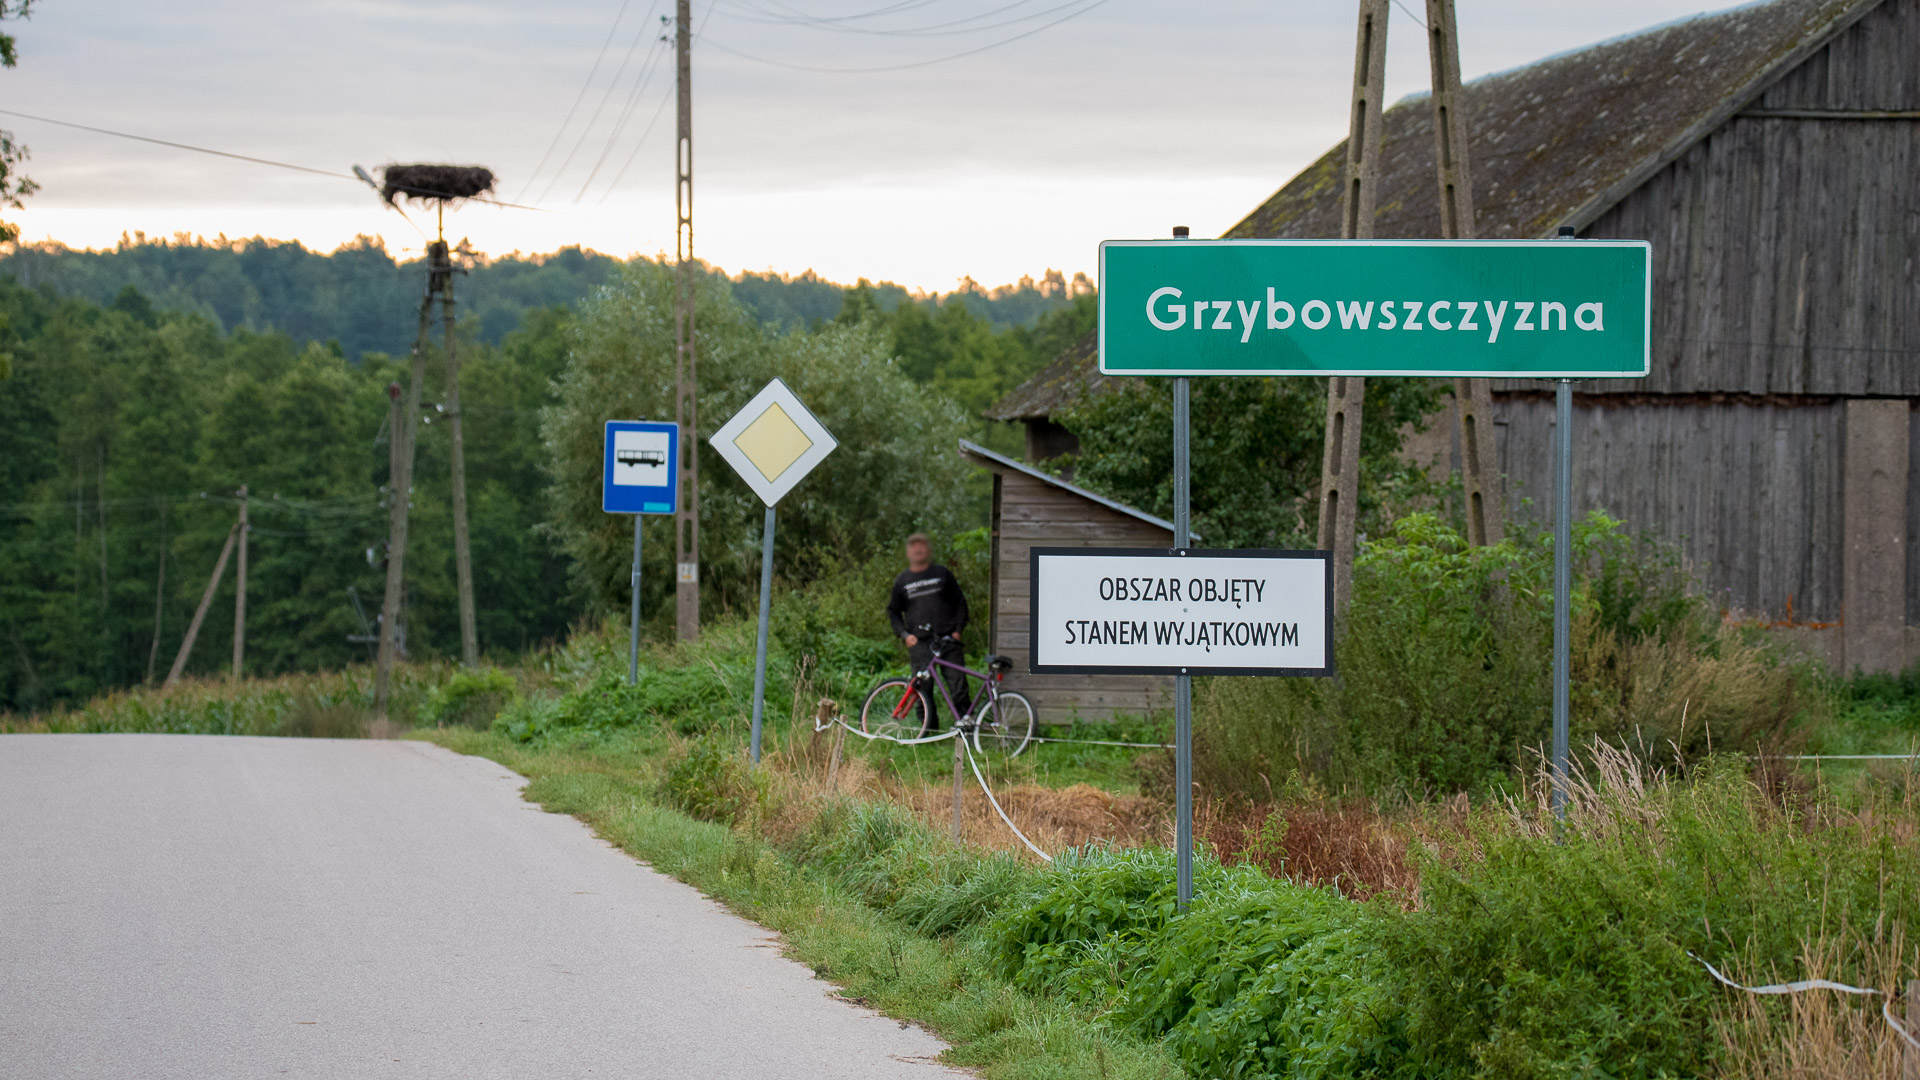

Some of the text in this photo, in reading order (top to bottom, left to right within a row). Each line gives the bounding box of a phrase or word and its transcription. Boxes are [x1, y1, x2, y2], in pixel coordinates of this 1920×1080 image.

[1145, 286, 1605, 344] Grzybowszczyzna
[1099, 577, 1266, 610] OBSZAR OBJĘTY
[1065, 619, 1299, 653] STANEM WYJĄTKOWYM
